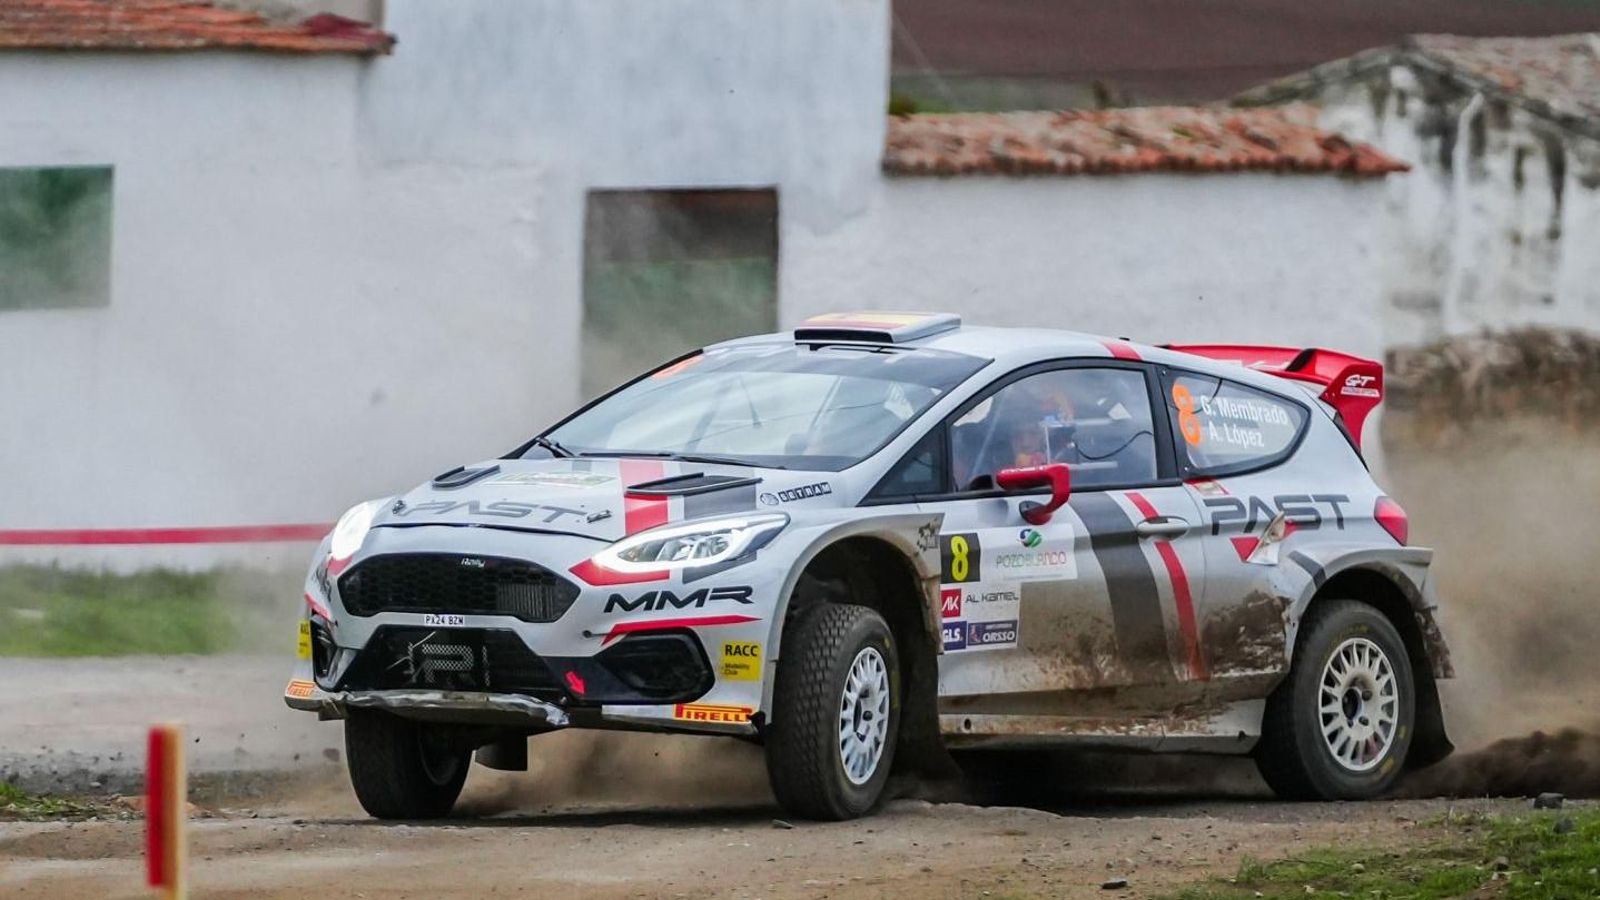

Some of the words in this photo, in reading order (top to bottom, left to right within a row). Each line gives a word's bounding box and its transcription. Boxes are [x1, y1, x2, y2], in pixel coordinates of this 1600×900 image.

[1172, 383, 1201, 446] 8
[1215, 398, 1288, 425] Membrado
[1208, 420, 1223, 442] A.
[1223, 423, 1265, 449] López
[401, 500, 587, 523] PAST
[1203, 494, 1350, 536] PAST
[951, 535, 969, 581] 8
[604, 585, 754, 613] MMR
[725, 645, 758, 657] RACC
[982, 631, 1016, 643] ORSSO
